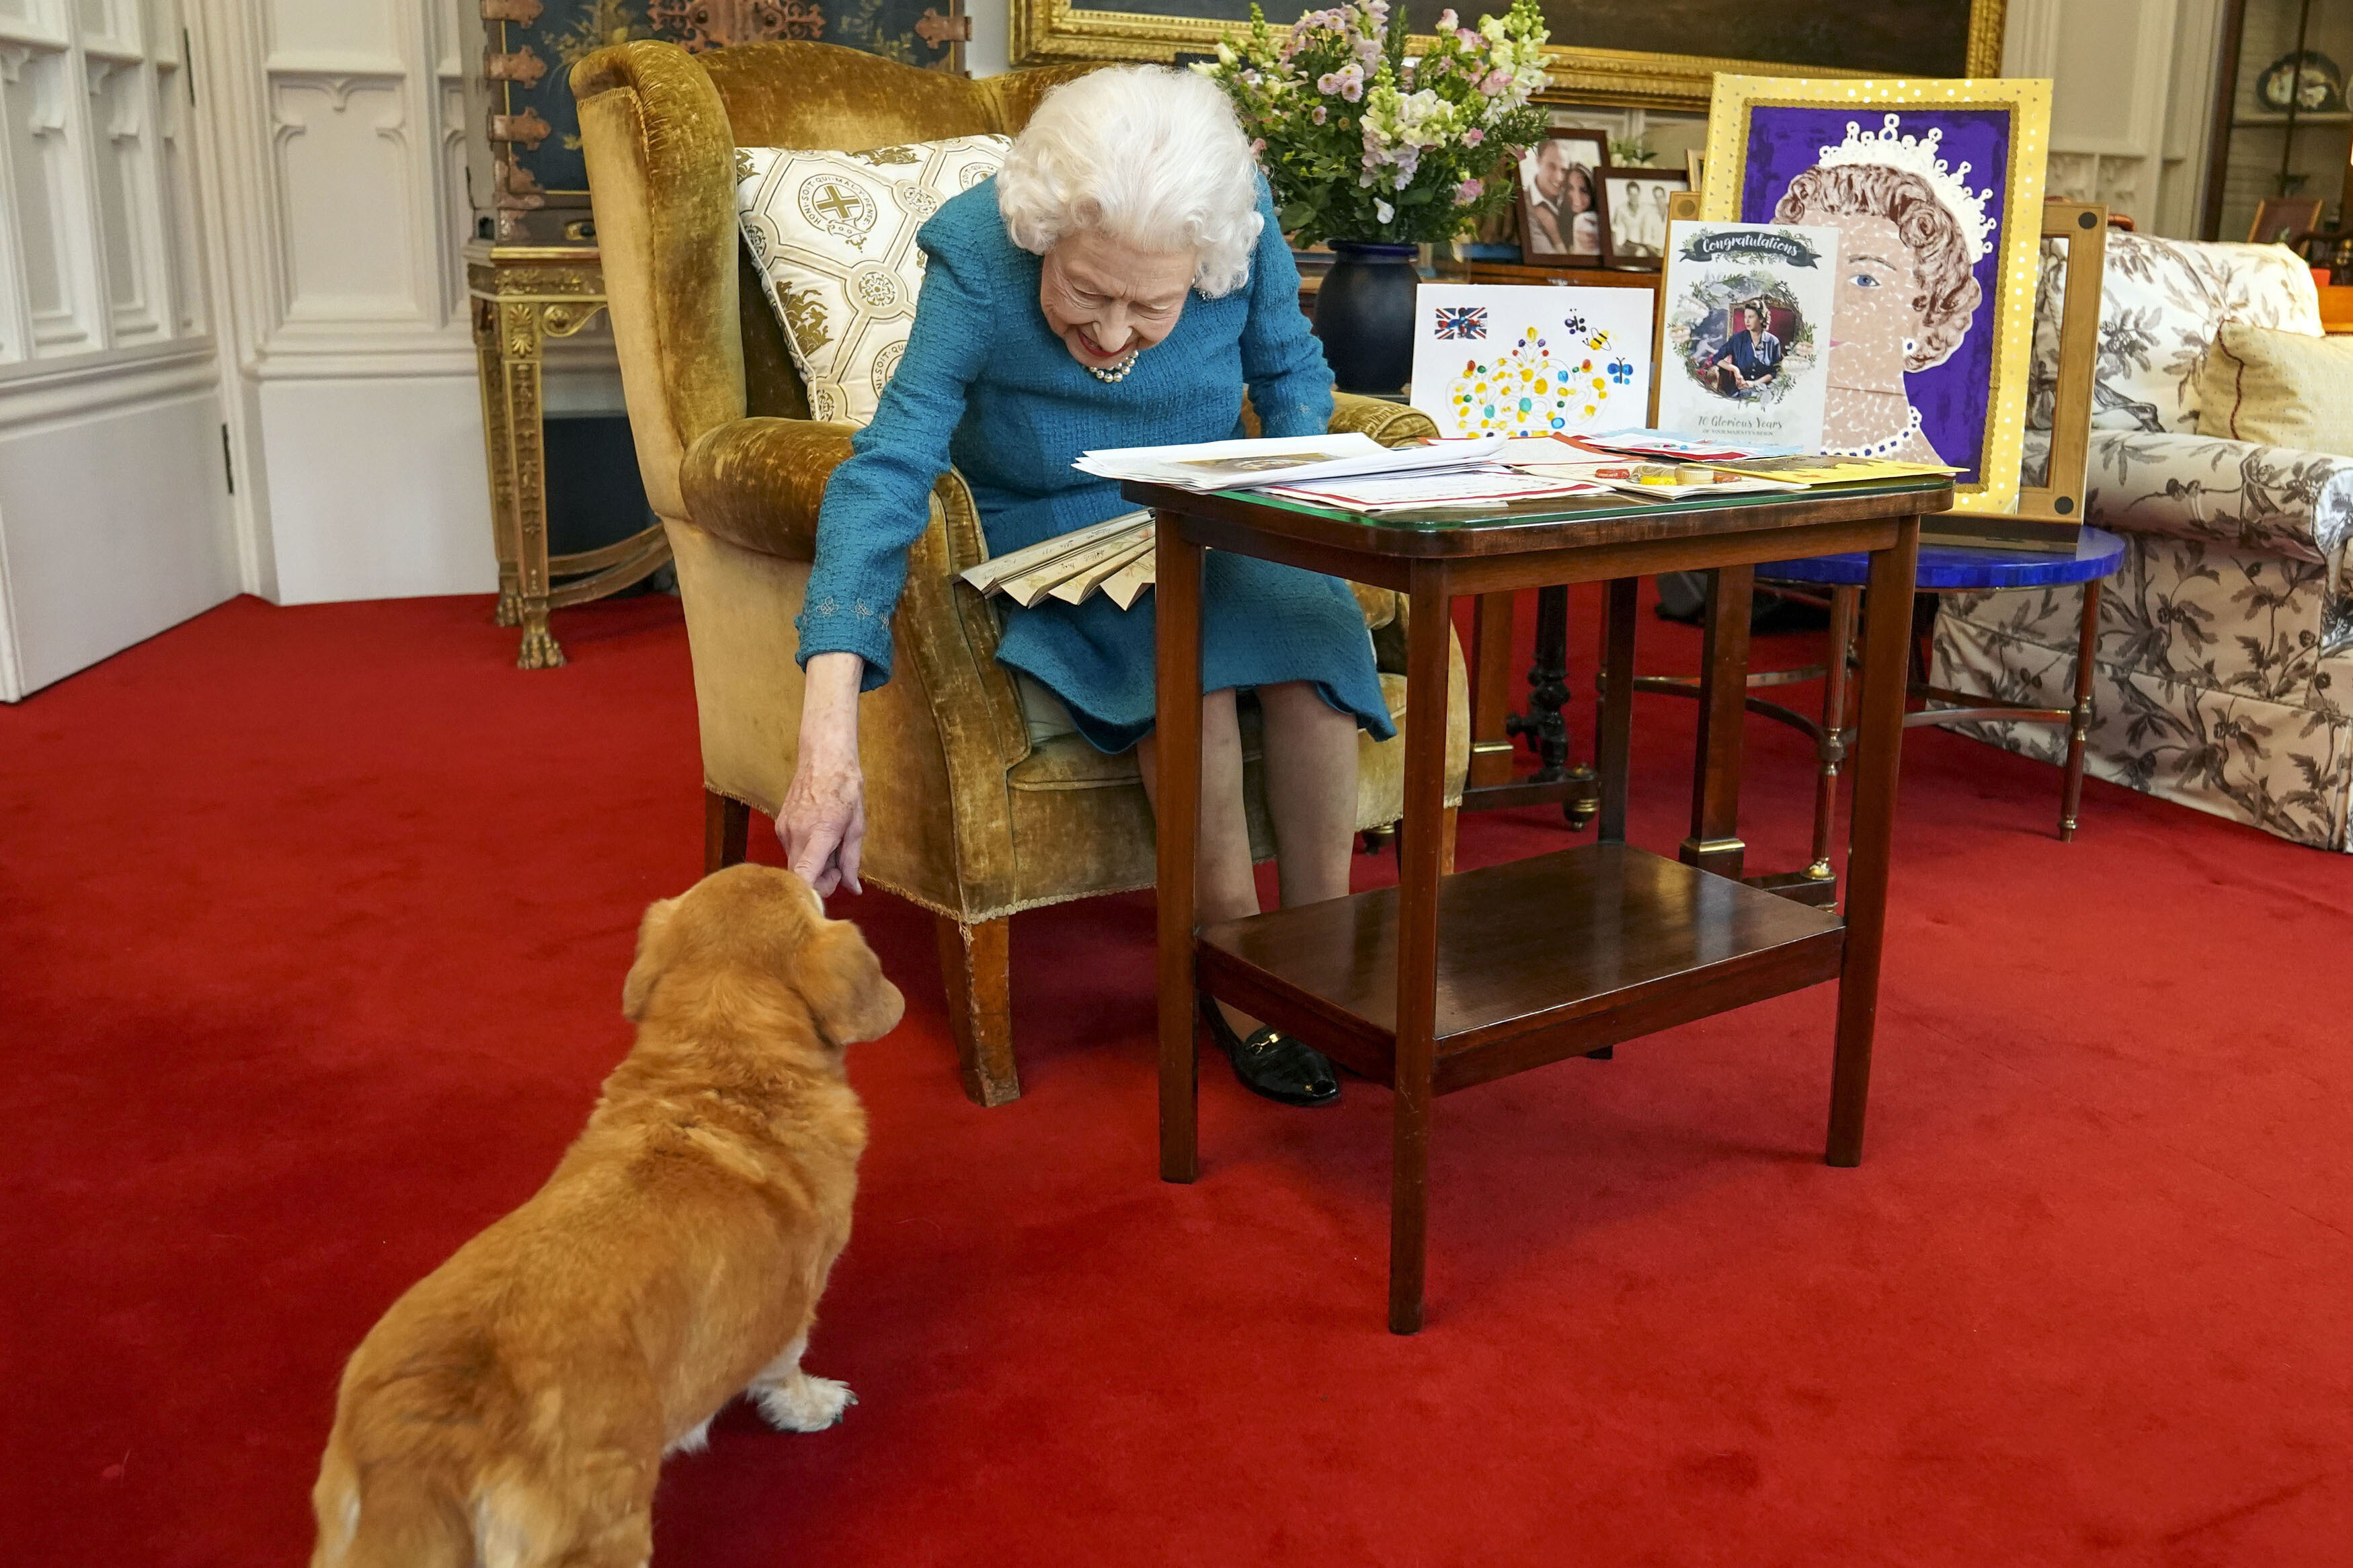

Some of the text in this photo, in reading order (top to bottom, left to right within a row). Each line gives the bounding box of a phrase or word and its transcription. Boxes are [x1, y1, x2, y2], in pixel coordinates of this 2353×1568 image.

[801, 181, 815, 201] SOIT
[835, 177, 856, 189] MAL
[803, 204, 822, 225] HONI
[1702, 233, 1798, 256] Congratulations
[875, 352, 889, 375] SOIT
[1698, 415, 1782, 429] 70 Glorious Years
